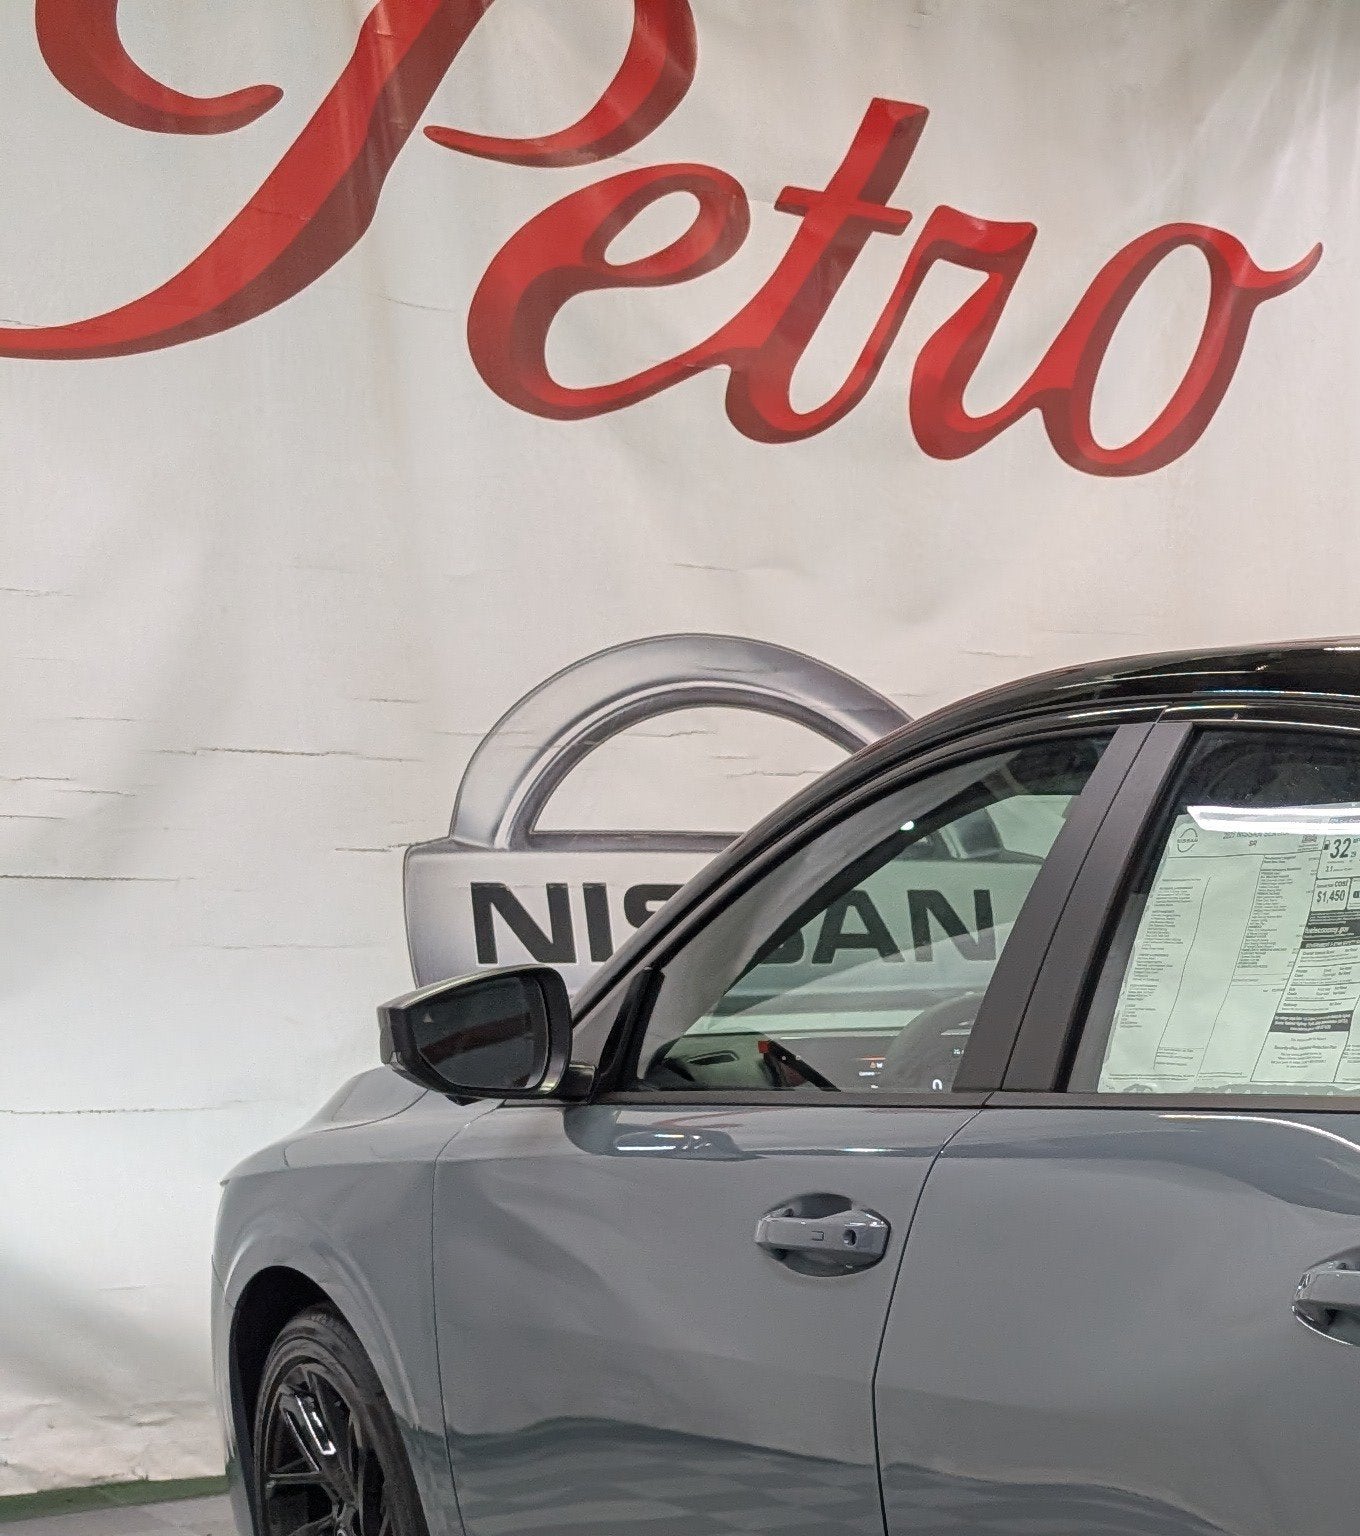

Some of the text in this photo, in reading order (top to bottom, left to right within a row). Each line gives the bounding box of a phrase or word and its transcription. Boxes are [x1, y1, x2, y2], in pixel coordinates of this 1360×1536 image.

[0, 0, 1323, 476] Petro
[1330, 838, 1352, 858] 32
[1316, 889, 1346, 904] $1,450
